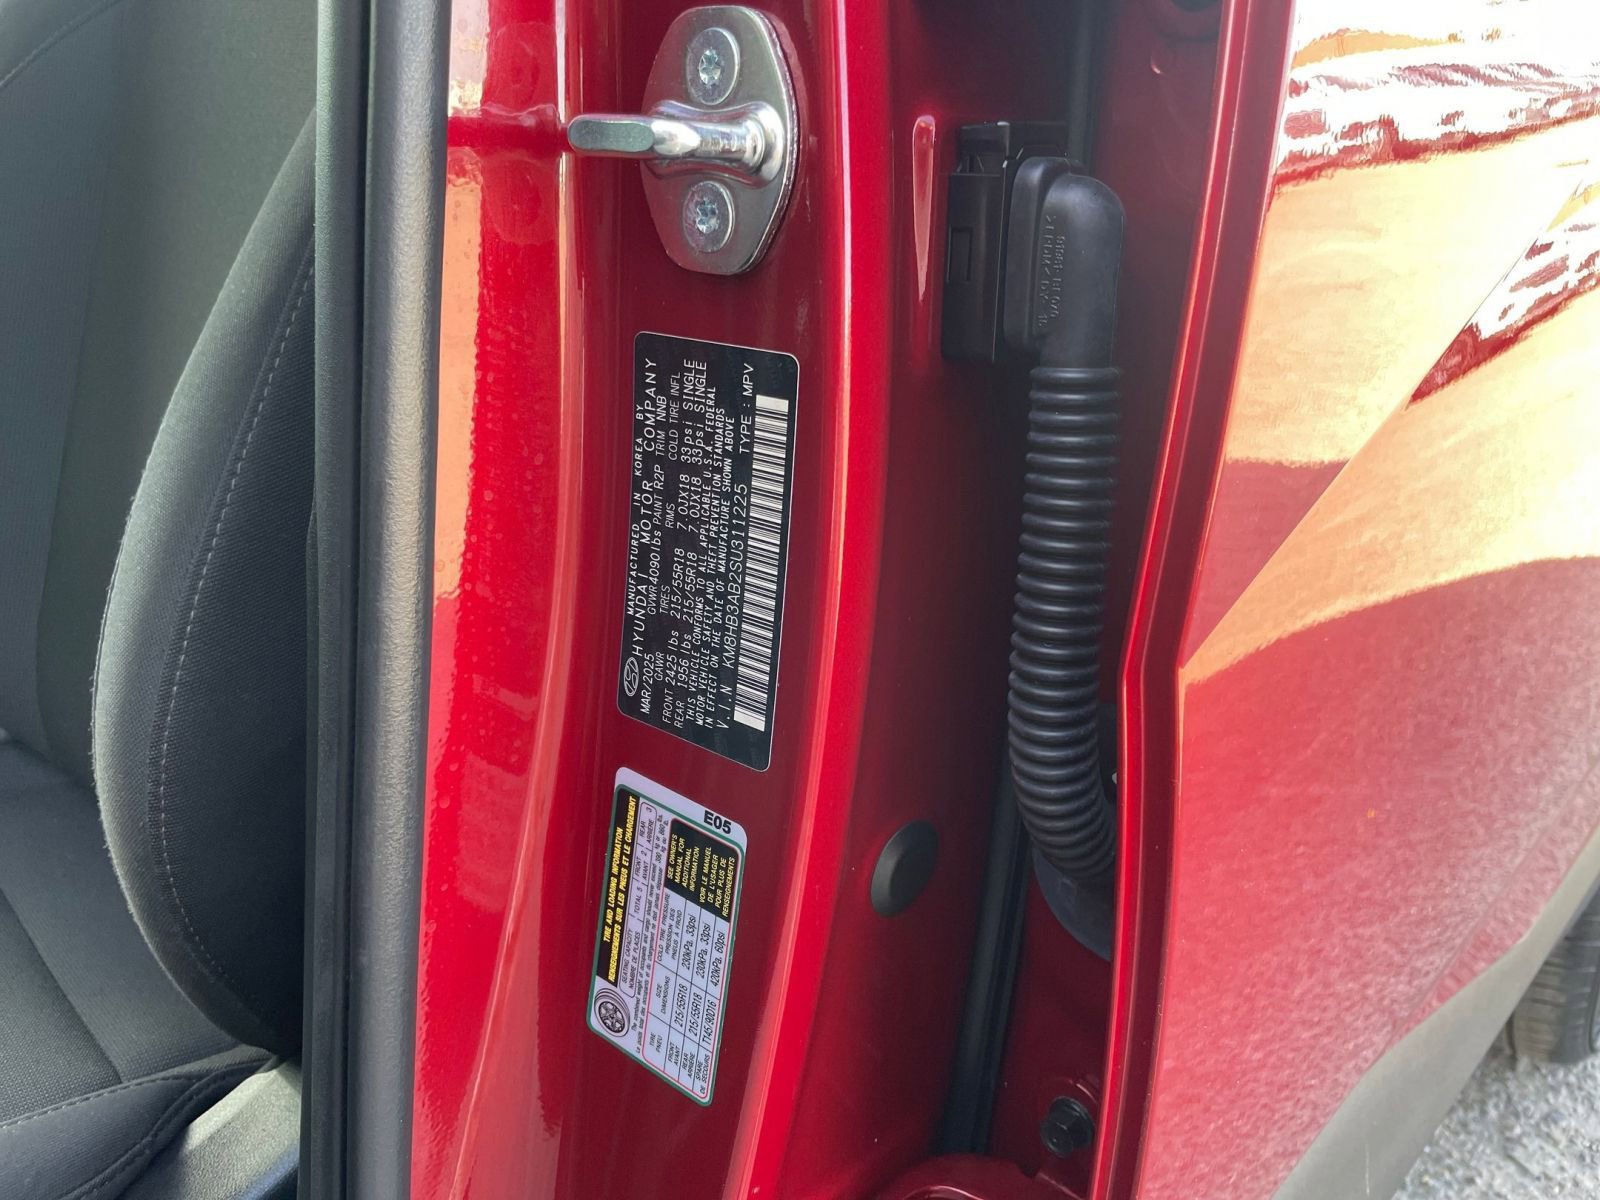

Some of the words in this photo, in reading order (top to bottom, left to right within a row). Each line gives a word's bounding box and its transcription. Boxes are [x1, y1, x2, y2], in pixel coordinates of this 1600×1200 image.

[670, 372, 680, 396] INFL
[683, 359, 695, 410] SINGLE
[694, 360, 706, 412] SINGLE
[743, 363, 754, 396] MPV
[636, 404, 643, 420] BY
[644, 358, 656, 451] COMPANY
[656, 396, 666, 421] NNB
[670, 400, 679, 423] TIRE
[706, 387, 716, 432] FEDERAL
[656, 430, 665, 456] TRIM
[669, 430, 678, 460] COLD
[714, 408, 724, 467] STANDARDS
[725, 417, 734, 452] ABOVE
[740, 414, 751, 454] TYPE
[703, 441, 712, 477] U.S.A.
[654, 465, 664, 489] R2P
[722, 458, 732, 492] SHOWN
[633, 492, 640, 506] IN
[640, 480, 653, 544] MOTOR
[652, 494, 662, 525] PAINT
[710, 474, 721, 538] PREVENTION
[665, 503, 675, 528] RIMS
[700, 484, 711, 548] APPLICABLE
[718, 499, 730, 572] MANUFACTURE
[627, 524, 640, 615] MANUFACTURED
[698, 555, 707, 572] ALL
[708, 544, 717, 574] THEFT
[670, 548, 684, 619] 215/55R18
[683, 552, 697, 623] 215/55R18
[696, 578, 705, 590] TO
[706, 581, 714, 600] AND
[716, 578, 724, 591] OF
[722, 484, 747, 668] KM8HB3AB2SU311225
[632, 573, 648, 656] HYUNDAI
[648, 585, 658, 614] GVWR
[660, 585, 670, 614] TIRES
[714, 598, 724, 624] DATE
[692, 596, 704, 644] CONFORMS
[702, 605, 712, 642] SAFETY
[668, 630, 679, 650] lbs
[680, 634, 691, 654] lbs
[712, 630, 721, 648] THE
[654, 652, 664, 680] GAWR
[666, 654, 676, 685] 2425
[678, 658, 689, 688] 1956
[689, 650, 699, 691] VEHICLE
[699, 648, 710, 688] VEHICLE
[710, 655, 718, 668] ON
[640, 653, 654, 714] MAR/2025
[706, 674, 717, 711] EFFECT
[662, 688, 673, 723] FRONT
[674, 701, 684, 728] REAR
[686, 698, 695, 721] THIS
[696, 695, 706, 726] MOTOR
[705, 717, 713, 728] IN
[625, 796, 636, 843] CHARGEMENT
[704, 810, 731, 834] E05
[612, 827, 623, 875] INFORMATION
[623, 855, 629, 866] ET
[624, 844, 630, 854] LE
[703, 847, 711, 873] MANUEL
[720, 857, 727, 867] DE
[619, 868, 627, 891] PNEUS
[675, 856, 683, 883] MANUAL
[682, 848, 691, 887] ADDITIONAL
[690, 847, 699, 891] INFORMATION
[702, 876, 707, 884] LE
[709, 855, 718, 889] L'USAGER
[608, 877, 617, 907] LOADING
[708, 892, 714, 902] DE
[722, 857, 735, 917] RENSEIGNEMENTS
[634, 896, 642, 913] TOTAL
[686, 914, 697, 936] 33psi
[700, 921, 711, 945] 33psi
[609, 924, 621, 982] RENSEIGNEMENTS
[625, 928, 633, 957] CAPACITY
[715, 931, 726, 953] 60psi
[622, 959, 630, 983] SEATING
[661, 976, 670, 1014] DIMENSIONS
[675, 984, 687, 1027] 215/55R18
[689, 992, 702, 1036] 215/55R18
[703, 1000, 716, 1045] T145/90D16
[702, 1054, 710, 1083] SECOURS
[700, 1085, 705, 1094] DE
